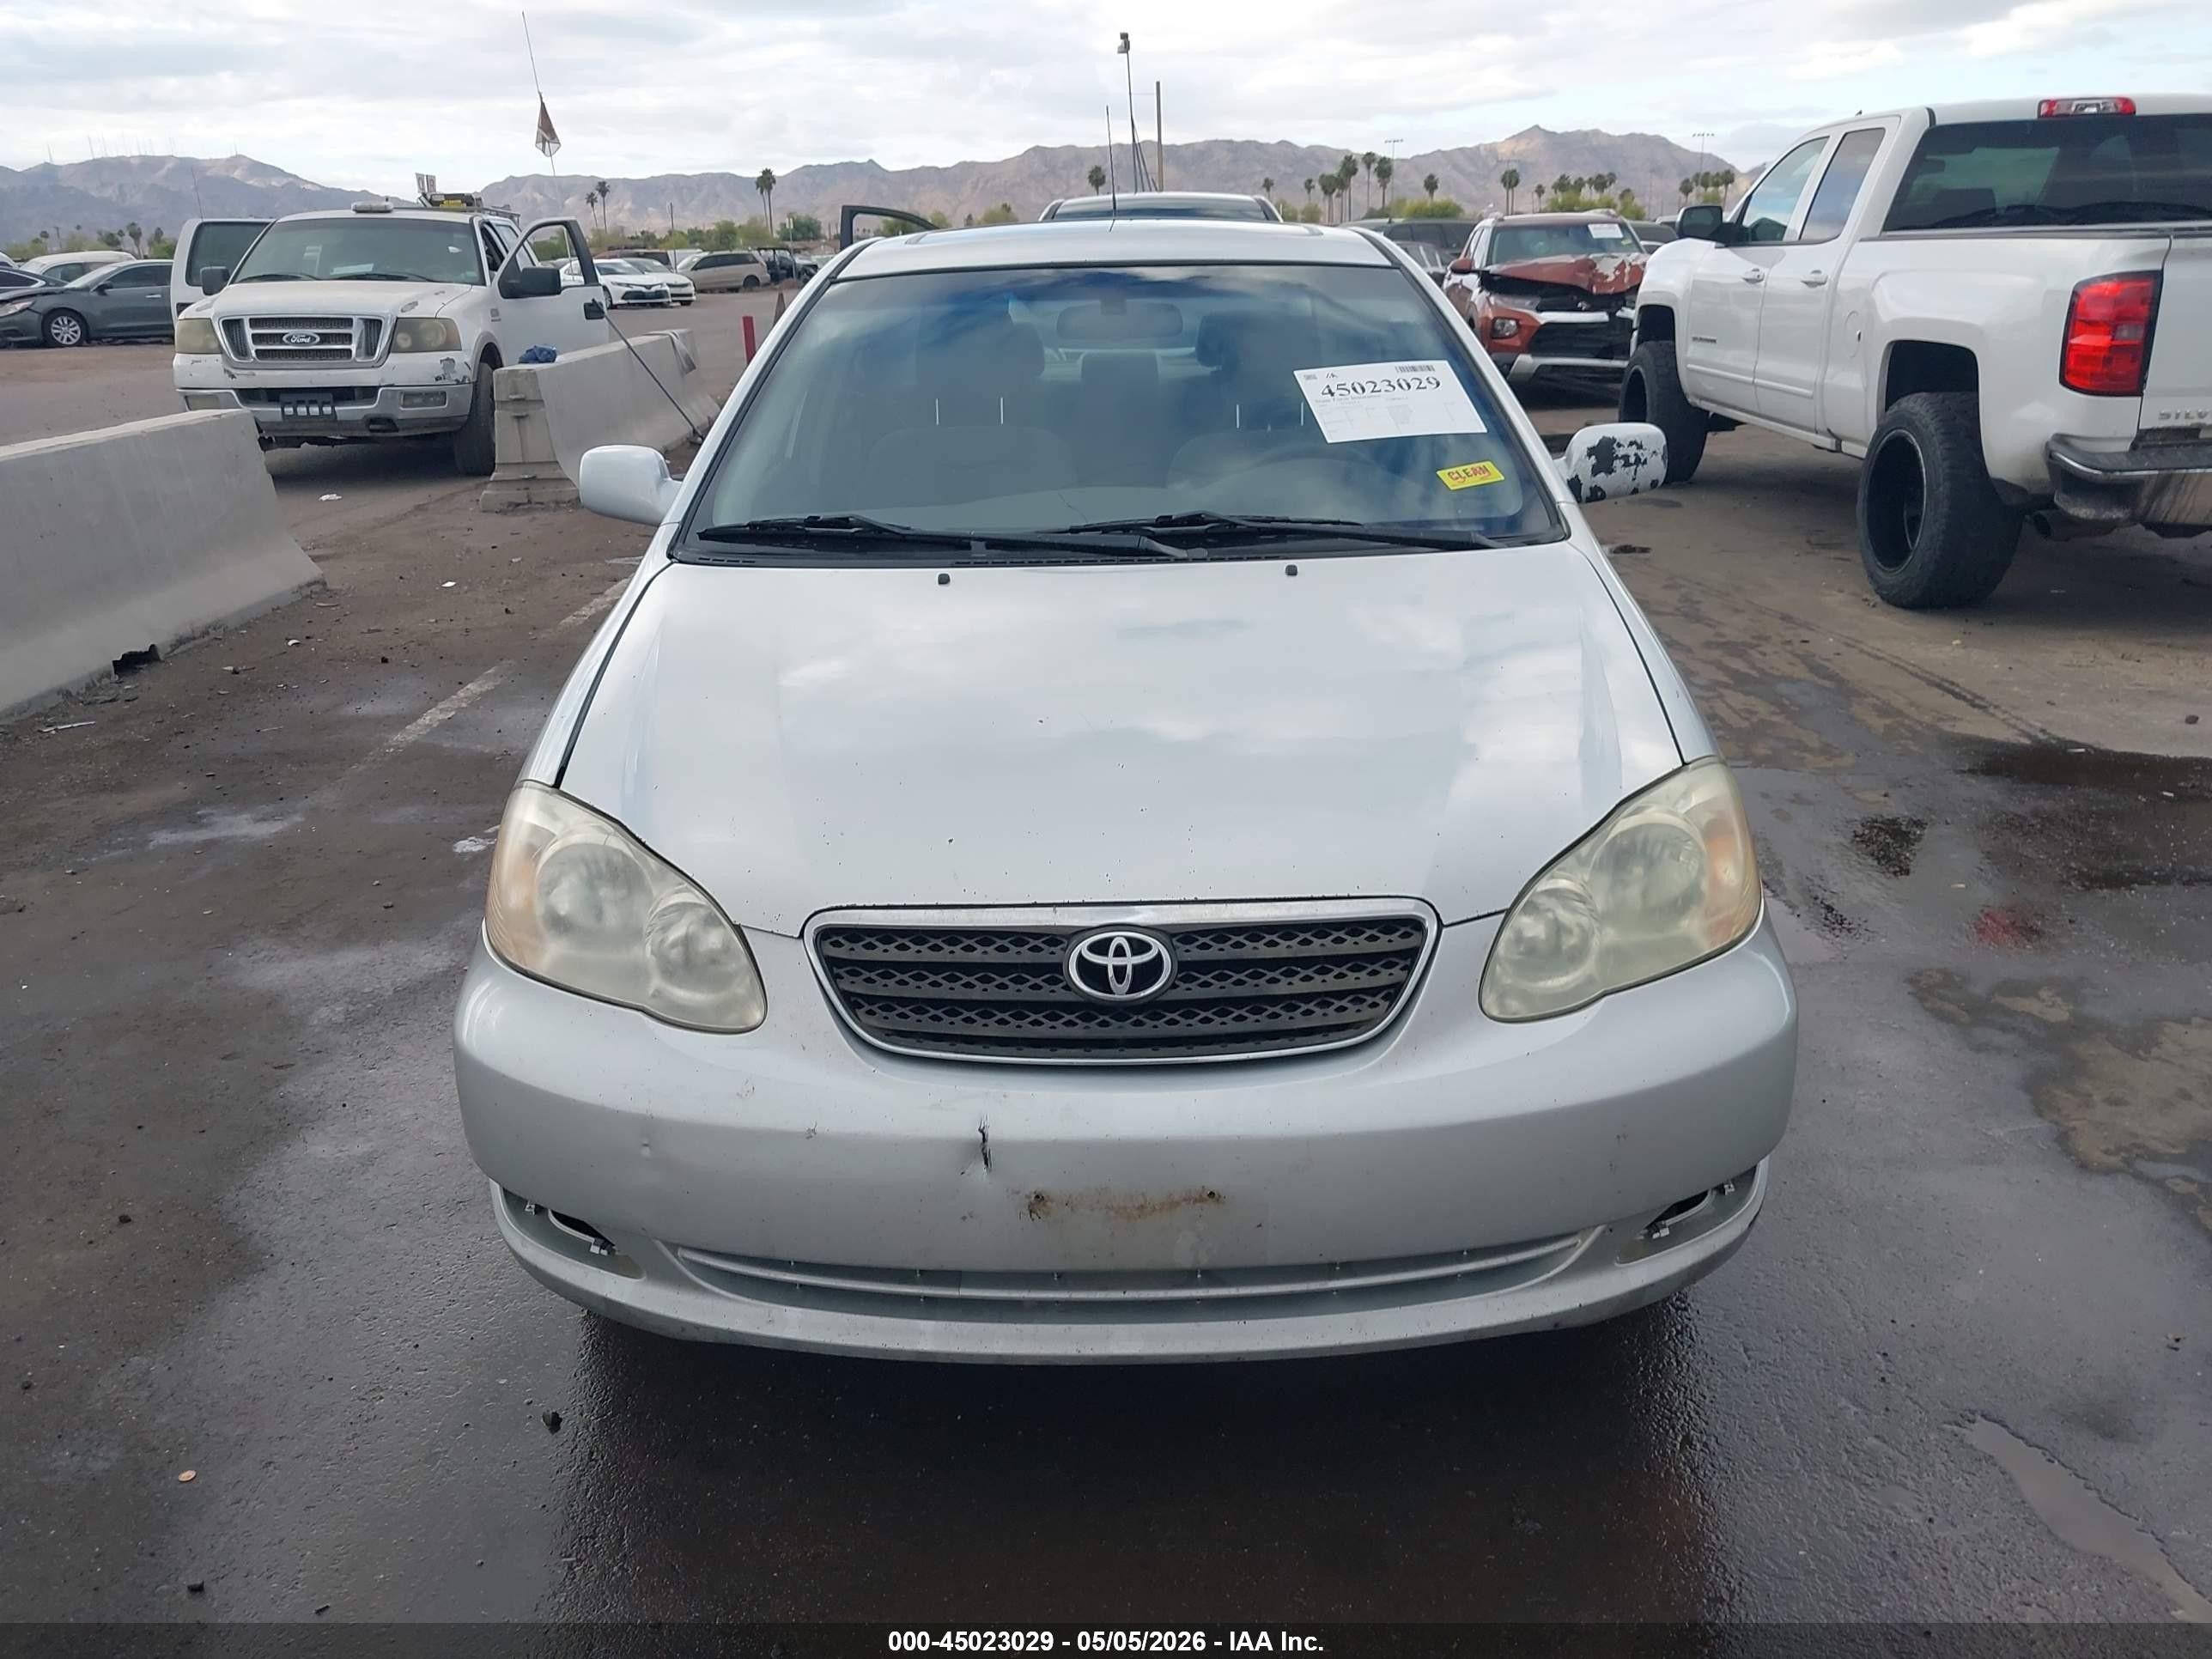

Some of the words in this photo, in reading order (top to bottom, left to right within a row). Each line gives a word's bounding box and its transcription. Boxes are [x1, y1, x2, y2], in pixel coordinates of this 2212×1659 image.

[290, 334, 311, 343] Ford
[1321, 376, 1441, 398] 45023029
[2158, 409, 2209, 420] SILV
[1447, 465, 1491, 481] CLEAN
